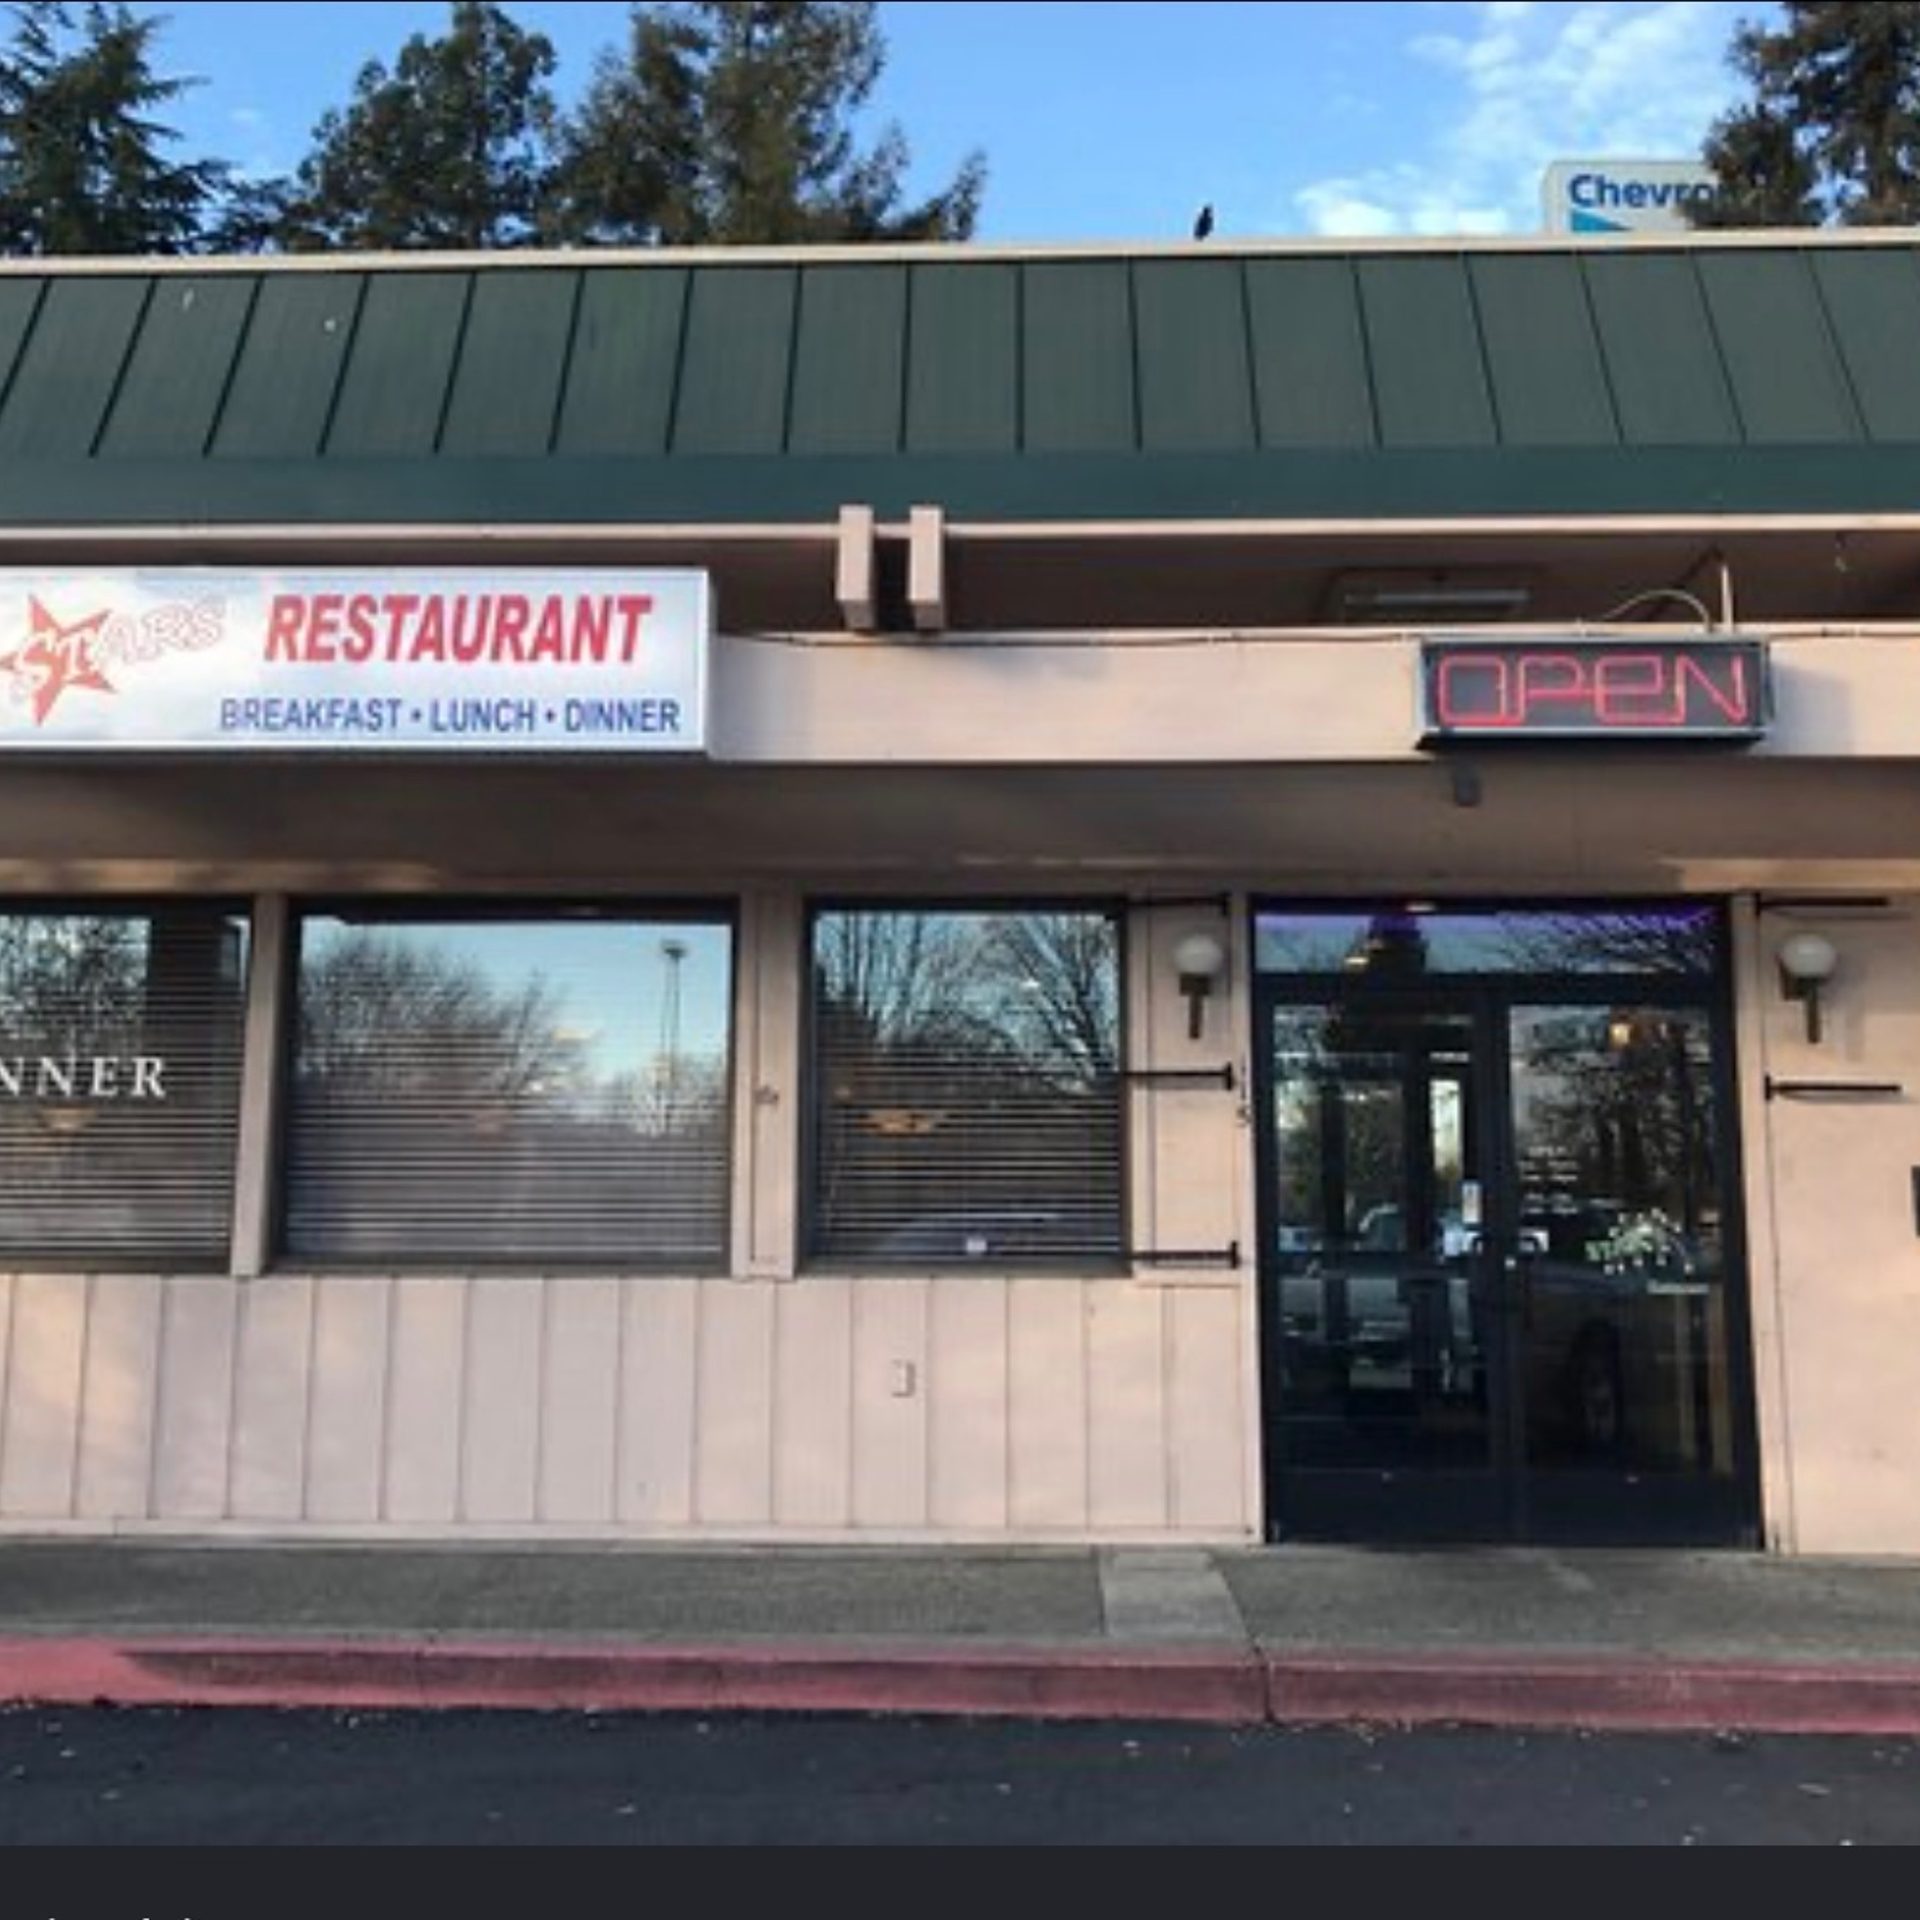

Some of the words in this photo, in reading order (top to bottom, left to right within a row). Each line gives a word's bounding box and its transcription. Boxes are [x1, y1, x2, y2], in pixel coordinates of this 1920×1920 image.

[1569, 173, 1722, 208] Chevro
[264, 594, 653, 663] RESTAURANT
[220, 698, 400, 732] BREAKFAST
[431, 698, 536, 733] LUNCH
[565, 698, 681, 733] DINNER
